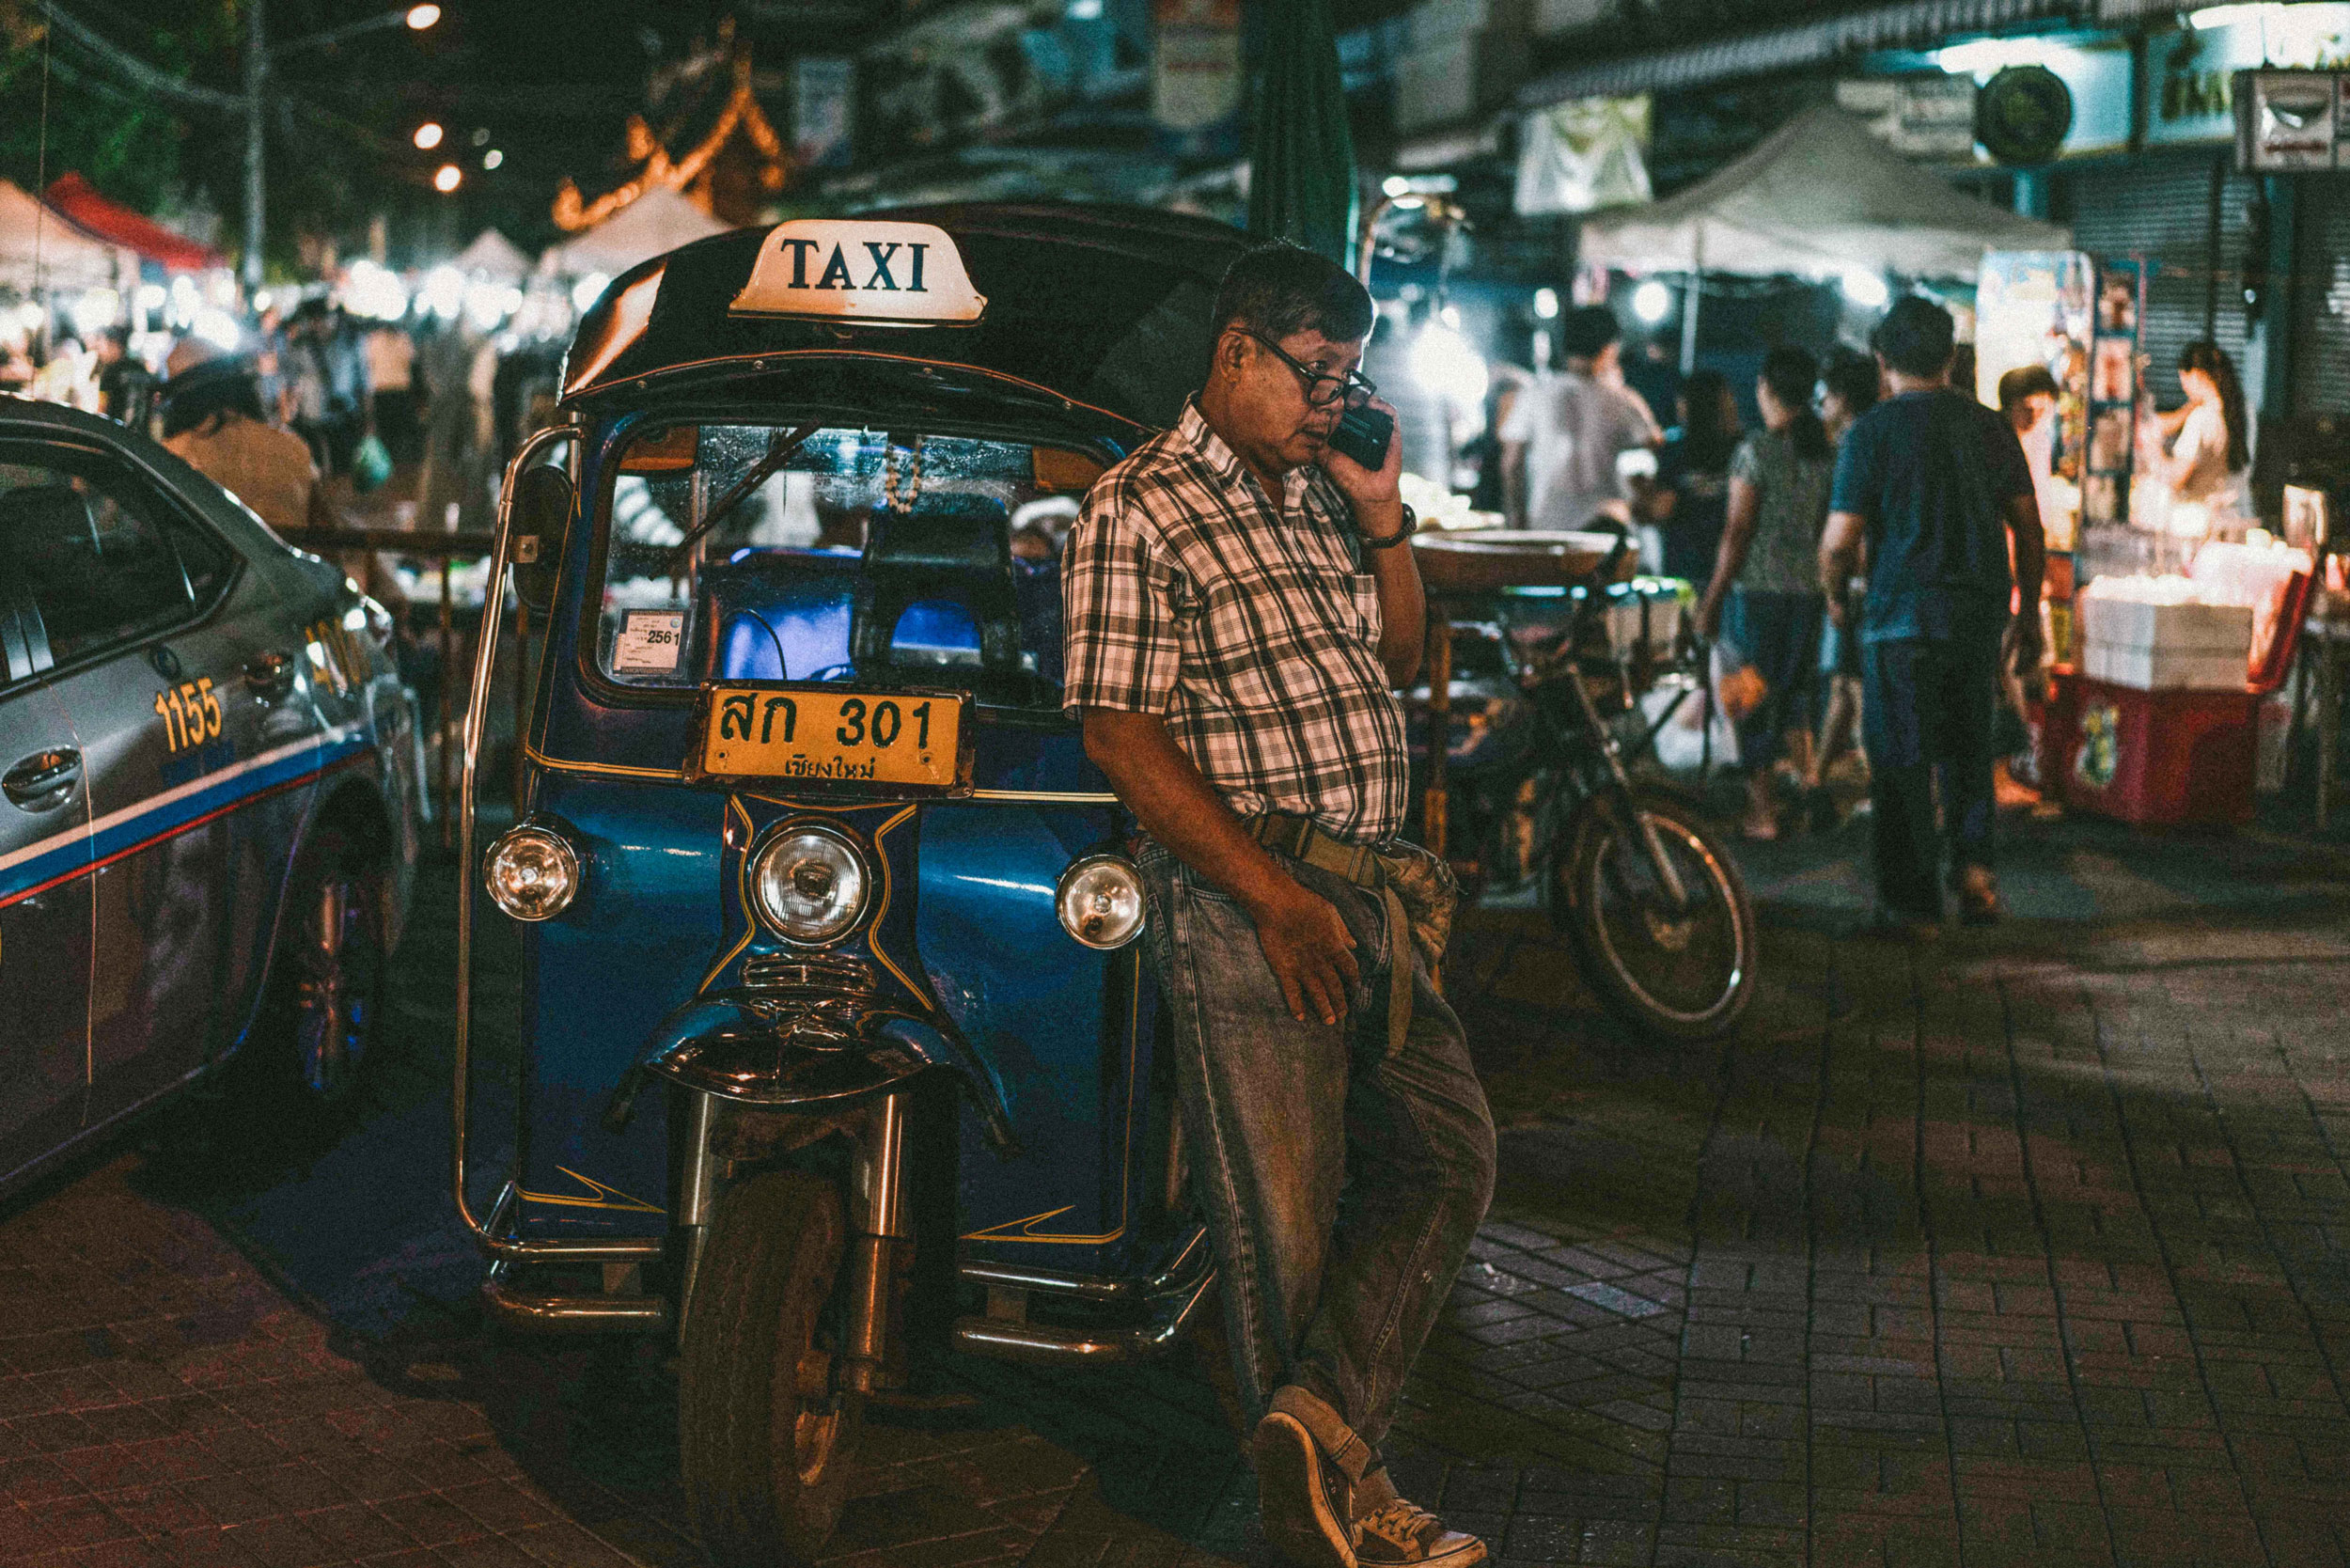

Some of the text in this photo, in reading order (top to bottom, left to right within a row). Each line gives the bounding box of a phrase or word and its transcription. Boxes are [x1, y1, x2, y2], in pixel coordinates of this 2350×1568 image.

[780, 238, 930, 292] TAXI
[647, 630, 681, 647] 2561
[154, 676, 222, 753] 1155
[721, 692, 932, 749] สก 301
[785, 753, 876, 779] เชียงใหม่
